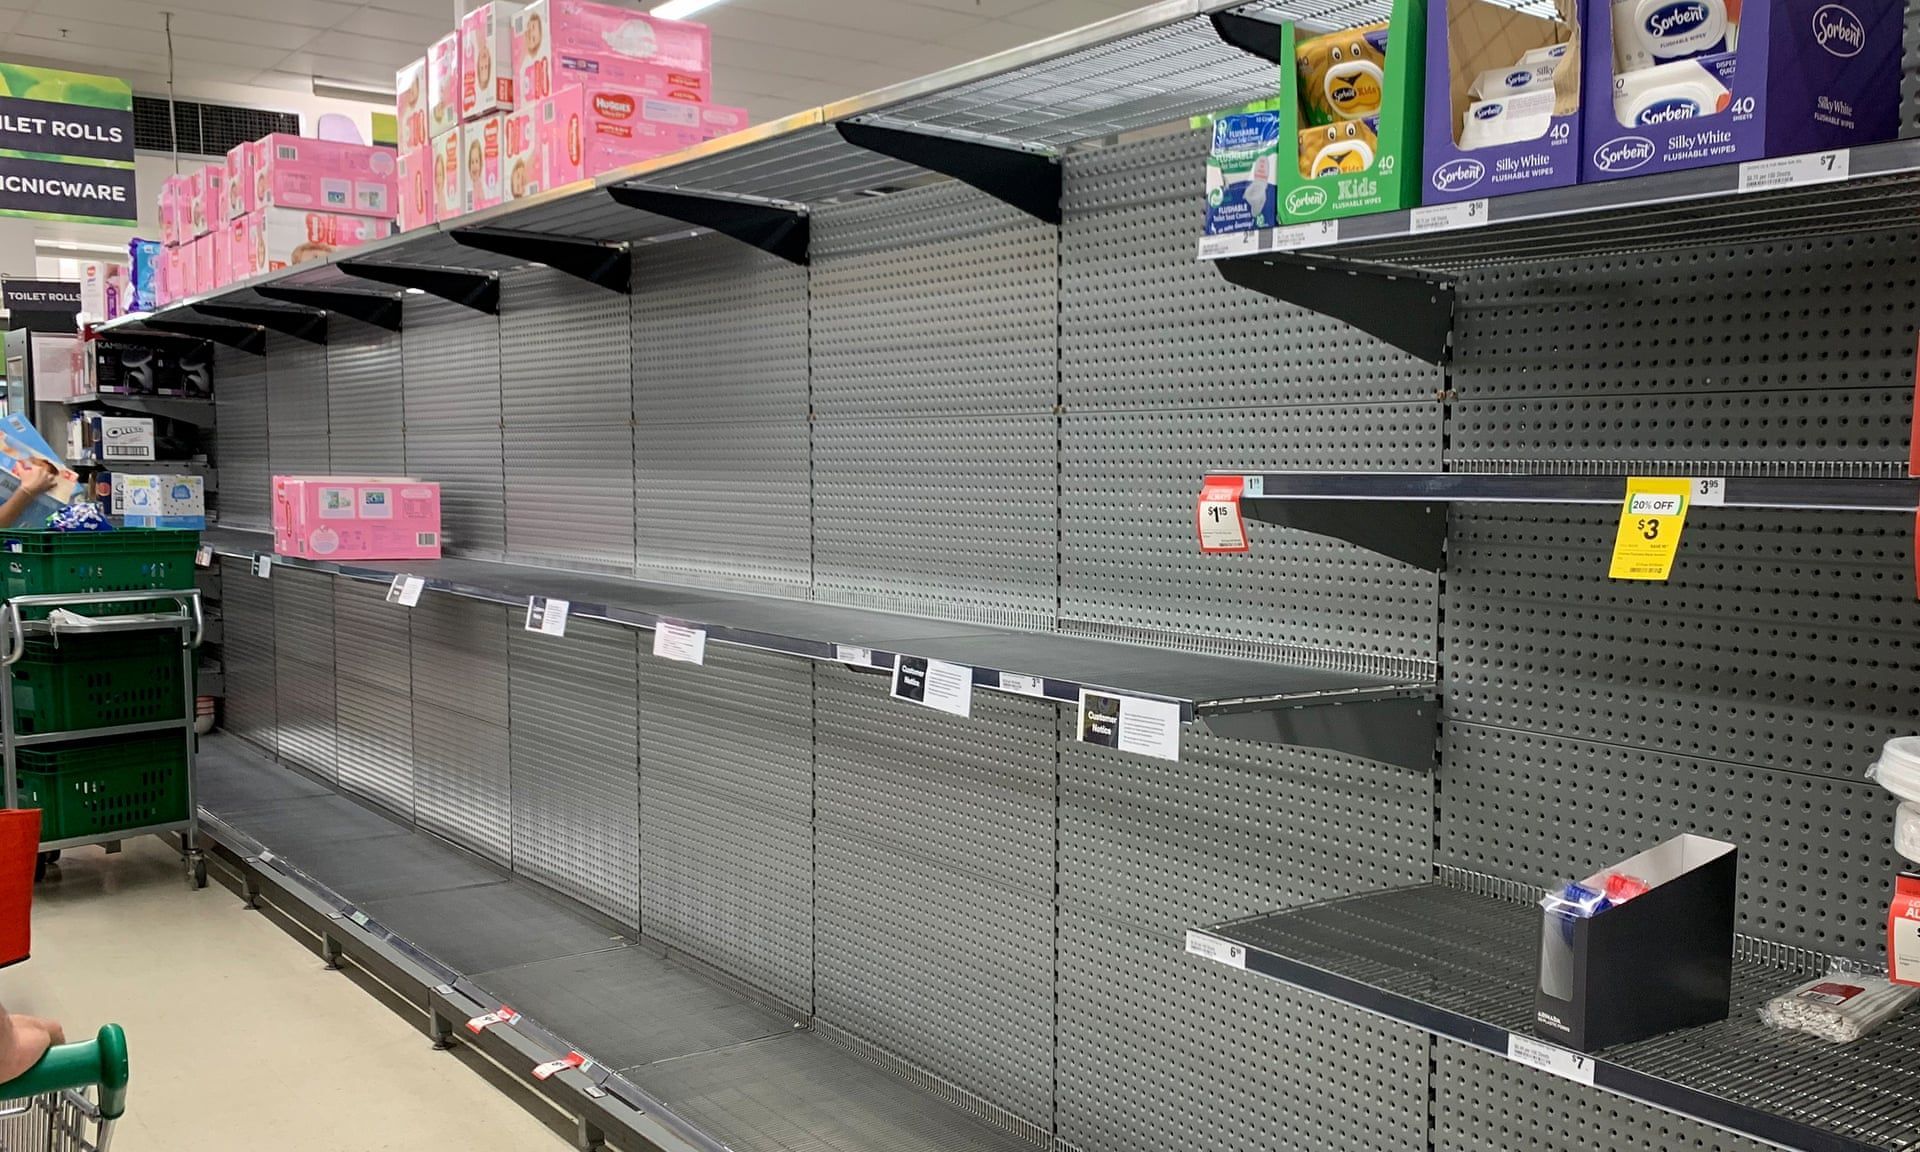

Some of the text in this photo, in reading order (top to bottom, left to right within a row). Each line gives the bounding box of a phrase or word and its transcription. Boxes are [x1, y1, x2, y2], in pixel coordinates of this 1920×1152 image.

[1650, 6, 1705, 37] Sorbent
[1817, 12, 1860, 48] Sorbent
[1731, 97, 1755, 114] 40
[51, 120, 123, 143] ROLLS
[1550, 123, 1570, 139] 40
[1668, 130, 1732, 150] Silky White
[1378, 155, 1395, 170] 40
[1495, 153, 1550, 173] Silky White
[1599, 143, 1650, 171] Sorbent
[1663, 144, 1736, 163] FLUSHABLE WIPES
[1820, 154, 1837, 171] $7
[1436, 164, 1482, 191] Sorbent
[1491, 166, 1554, 183] FLUSHABLE WIPES
[1337, 176, 1378, 201] Kids
[1289, 191, 1324, 214] Sorbent
[8, 292, 46, 302] TOILET
[1632, 501, 1674, 510] 20% OFF
[1637, 518, 1660, 540] $3
